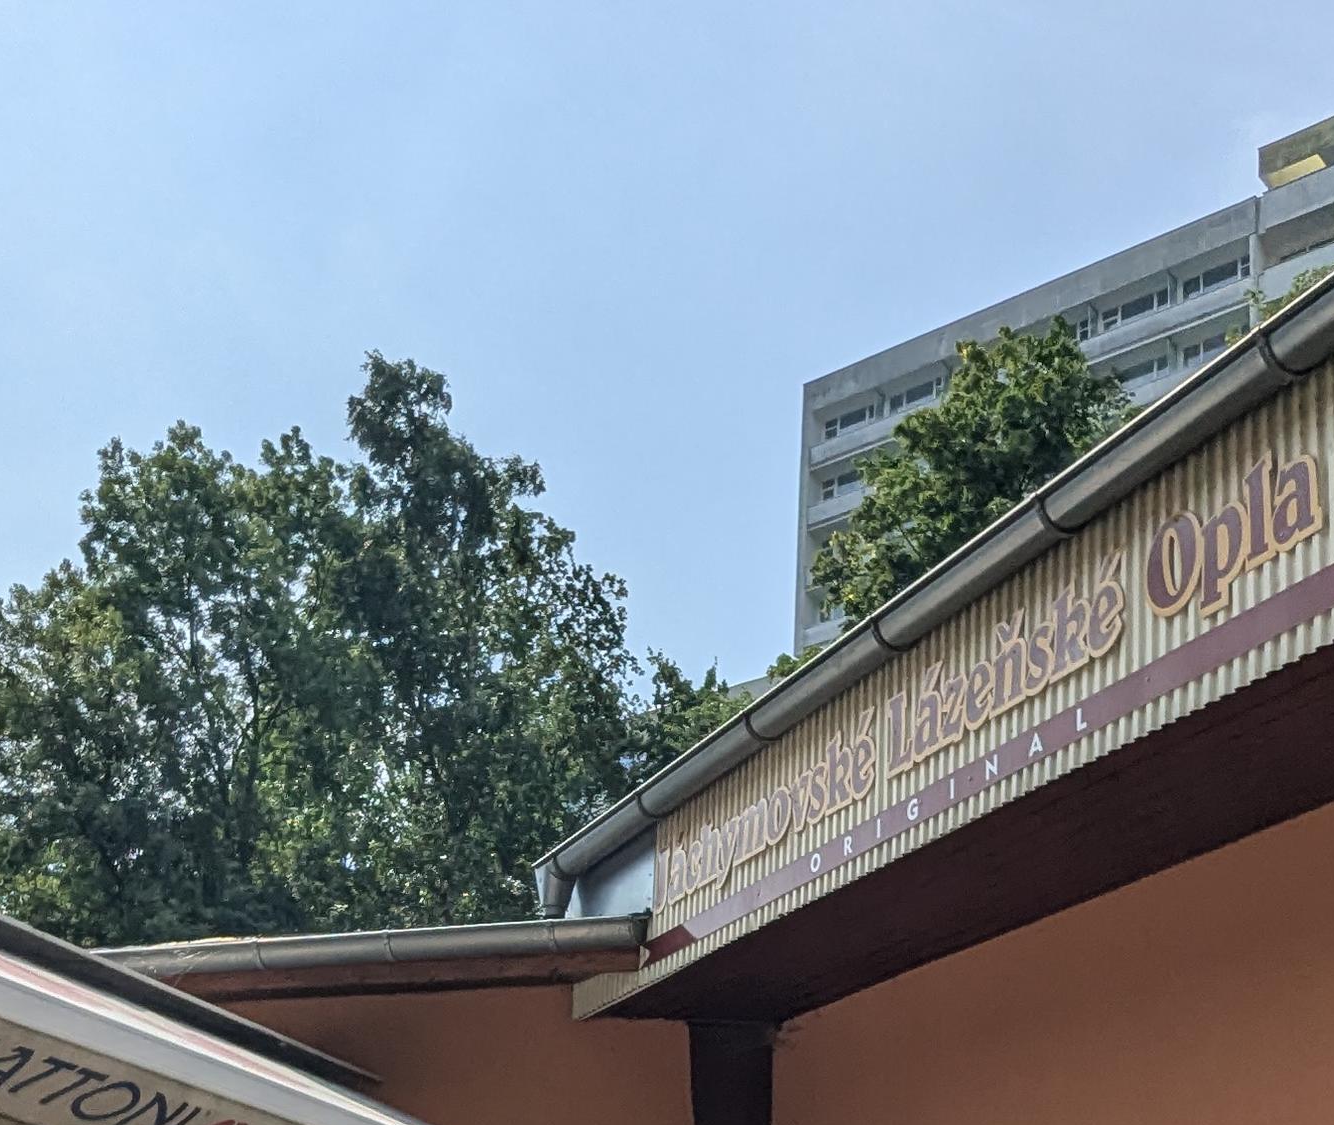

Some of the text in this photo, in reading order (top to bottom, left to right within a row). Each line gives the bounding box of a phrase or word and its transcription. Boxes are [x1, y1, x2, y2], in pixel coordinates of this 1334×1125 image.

[653, 706, 876, 915] Jáchymovské
[887, 546, 1126, 779] Lázeňské
[810, 708, 1087, 873] ORIGINAL
